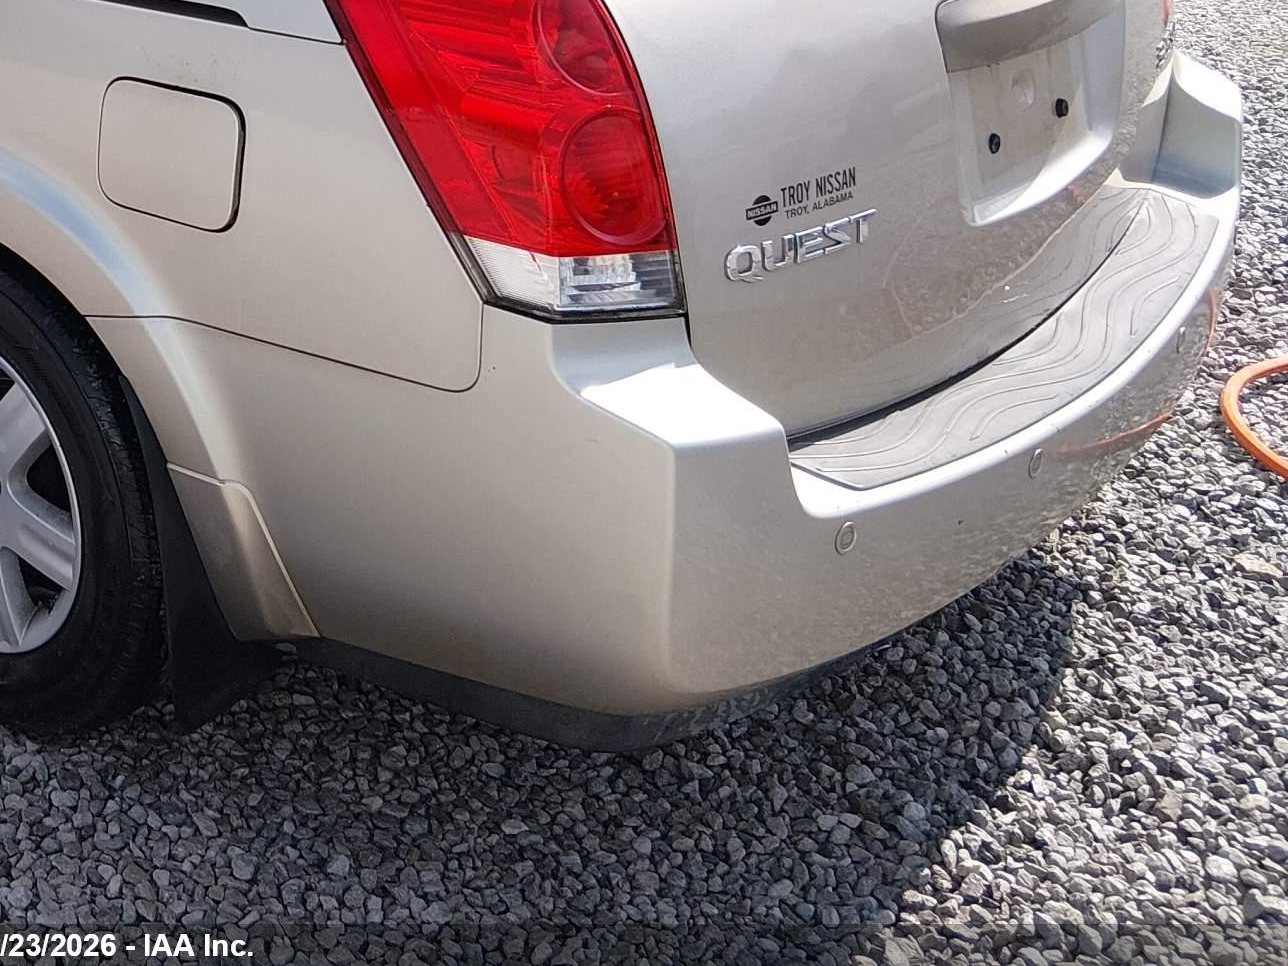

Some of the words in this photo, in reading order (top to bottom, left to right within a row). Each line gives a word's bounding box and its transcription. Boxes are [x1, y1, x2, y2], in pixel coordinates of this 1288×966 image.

[780, 179, 810, 207] TROY
[815, 166, 856, 198] NISSAN
[746, 202, 777, 219] NISSAN
[784, 204, 810, 219] TROY,
[811, 191, 853, 212] ALABAMA
[724, 208, 877, 283] QUEST
